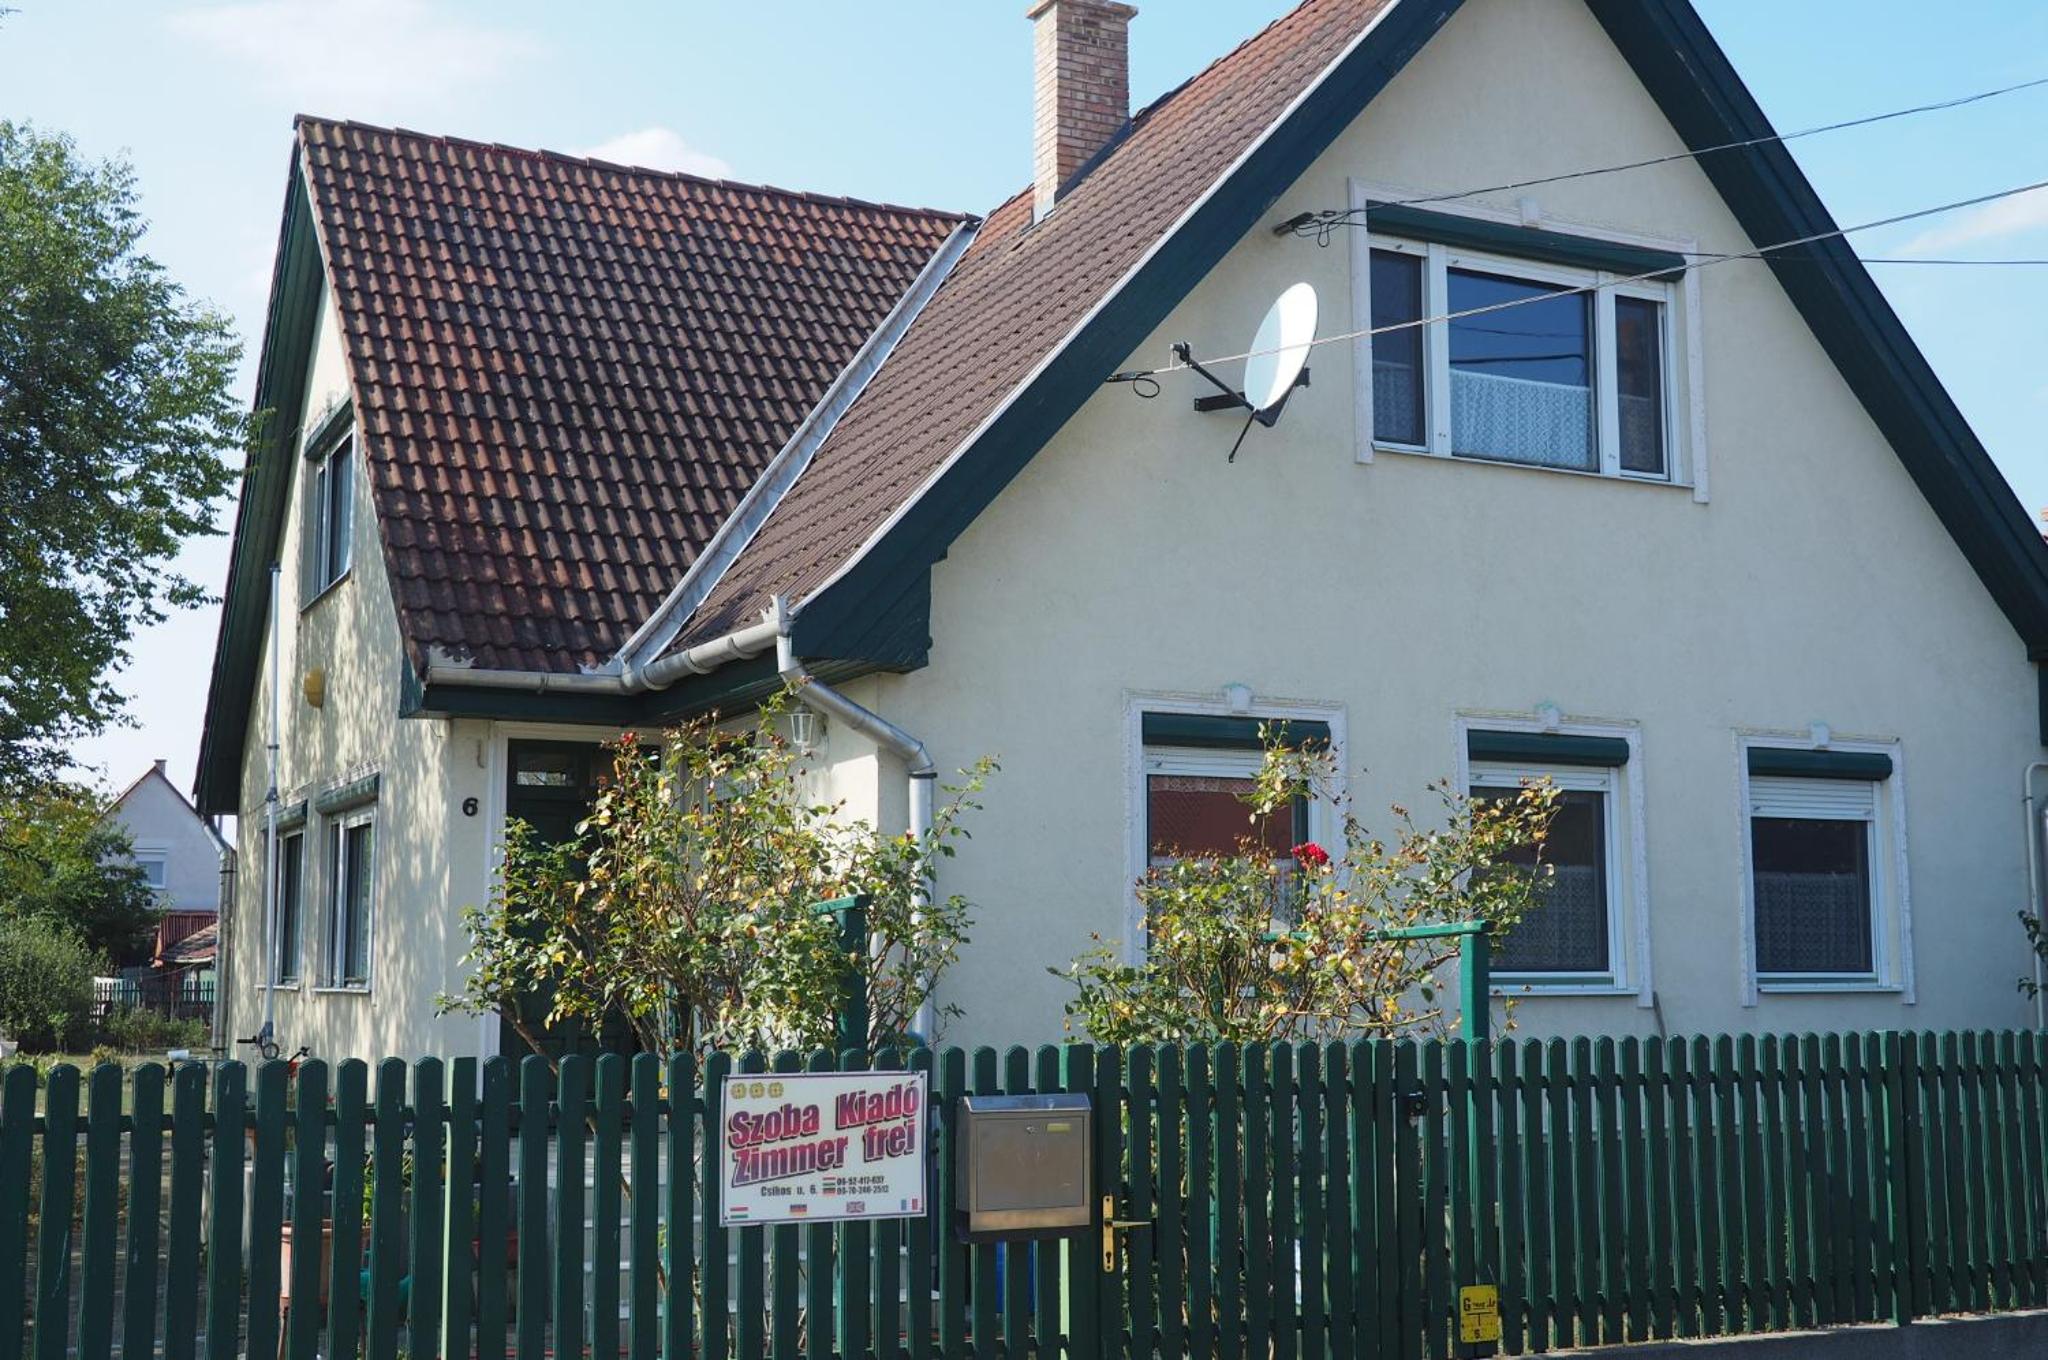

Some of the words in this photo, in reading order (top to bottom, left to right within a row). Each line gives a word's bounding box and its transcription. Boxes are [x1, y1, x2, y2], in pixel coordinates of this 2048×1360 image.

[462, 797, 478, 817] 6
[729, 1102, 820, 1148] Szoba
[836, 1081, 919, 1130] Kiadó
[732, 1136, 848, 1186] Zimmer
[863, 1119, 915, 1162] frei
